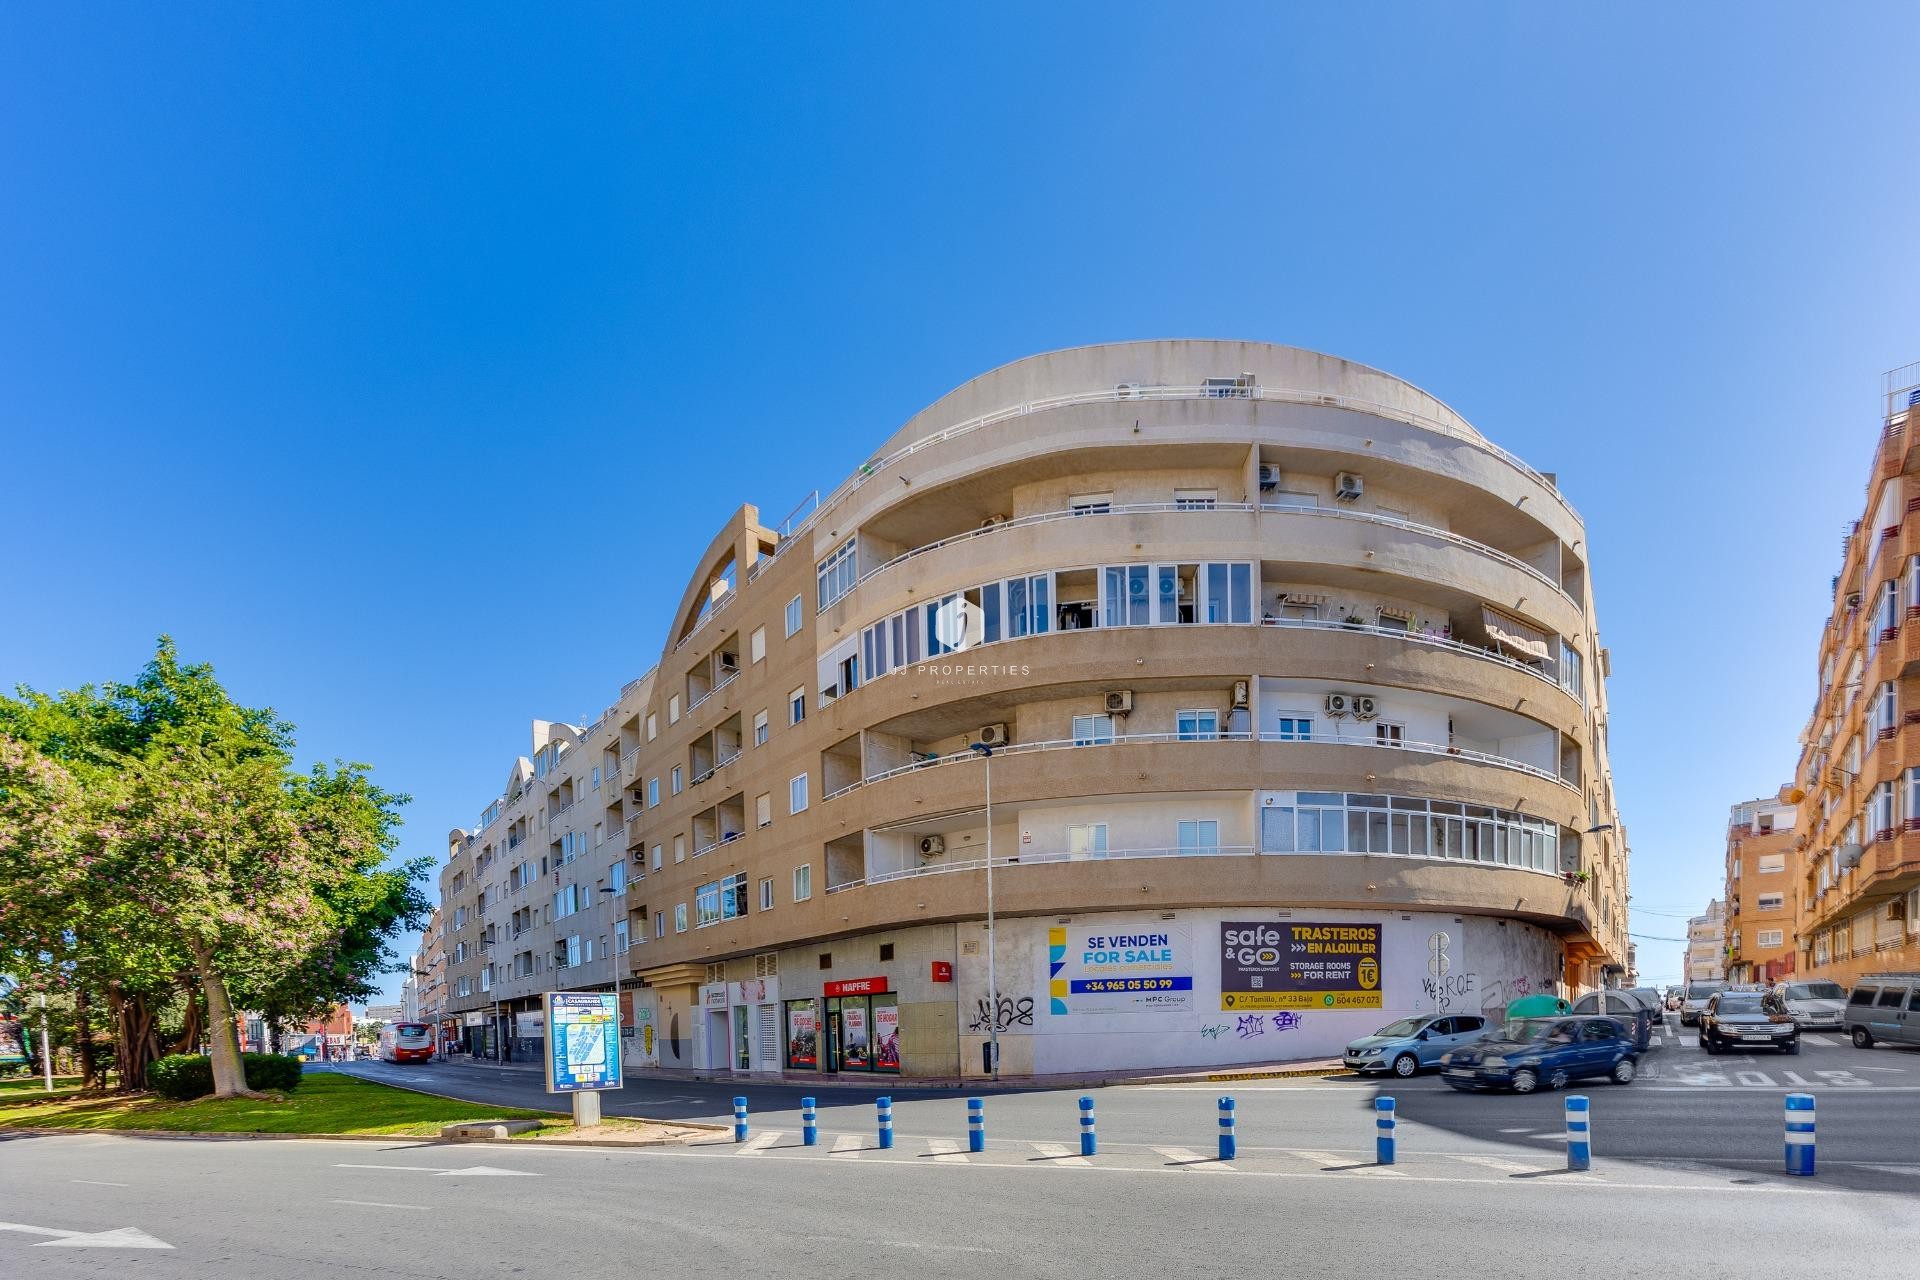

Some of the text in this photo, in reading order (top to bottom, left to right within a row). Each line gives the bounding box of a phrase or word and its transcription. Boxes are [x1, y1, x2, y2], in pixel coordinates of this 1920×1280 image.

[1225, 925, 1280, 946] safe
[1291, 927, 1376, 940] TRASTEROS
[1088, 934, 1168, 949] SE VENDEN
[1225, 947, 1236, 959] &
[1307, 943, 1376, 954] EN ALQUILER
[1083, 949, 1172, 964] FOR SALE
[1290, 962, 1324, 970] STORAGE
[1326, 962, 1351, 970] ROOMS
[1303, 971, 1351, 980] FOR RENT
[1361, 969, 1375, 983] 1€
[842, 981, 871, 992] MAPFRE
[1085, 980, 1173, 991] +34 965 05 50 99
[1336, 996, 1350, 1004] 604
[1366, 996, 1379, 1004] 073
